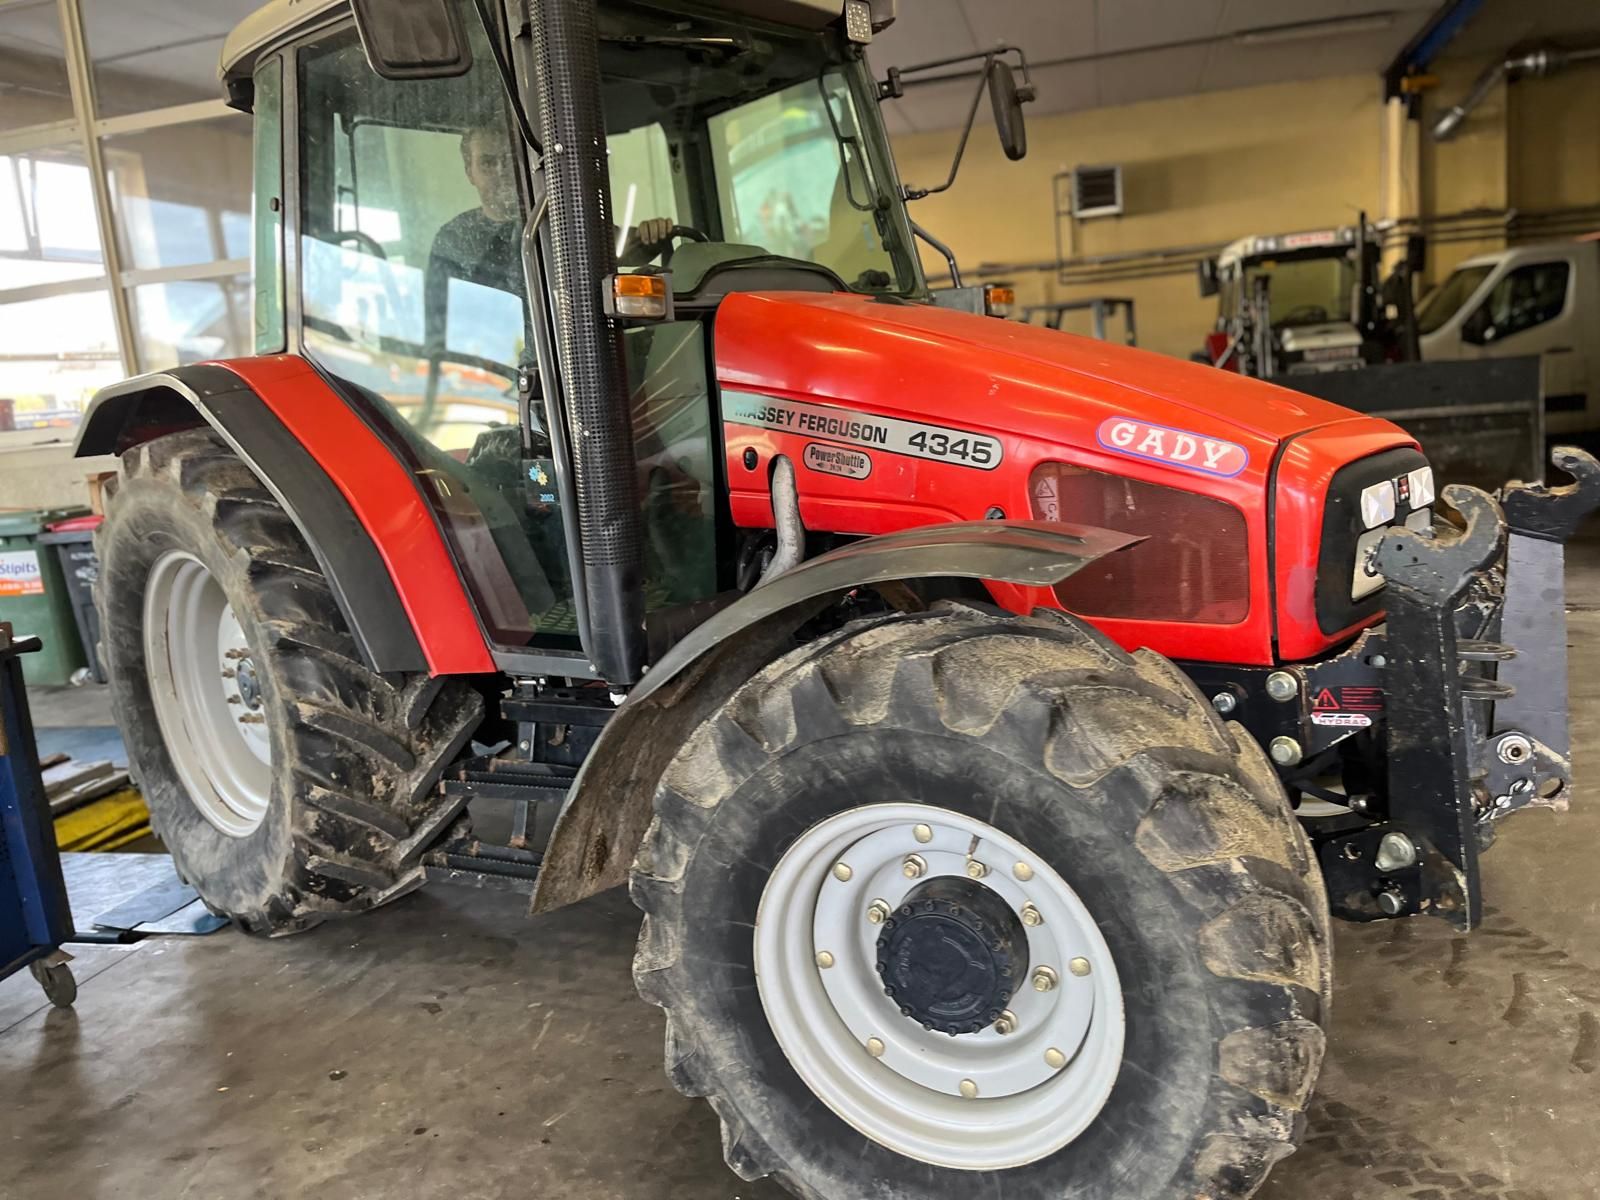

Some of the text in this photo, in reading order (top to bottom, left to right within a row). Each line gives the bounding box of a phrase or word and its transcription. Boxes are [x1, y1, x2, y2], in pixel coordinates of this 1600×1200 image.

[798, 413, 888, 444] FERGUSON
[908, 431, 993, 464] 4345
[1110, 421, 1232, 469] GADY
[810, 446, 865, 469] PowerShuttle
[1318, 718, 1368, 726] HYDRAC
